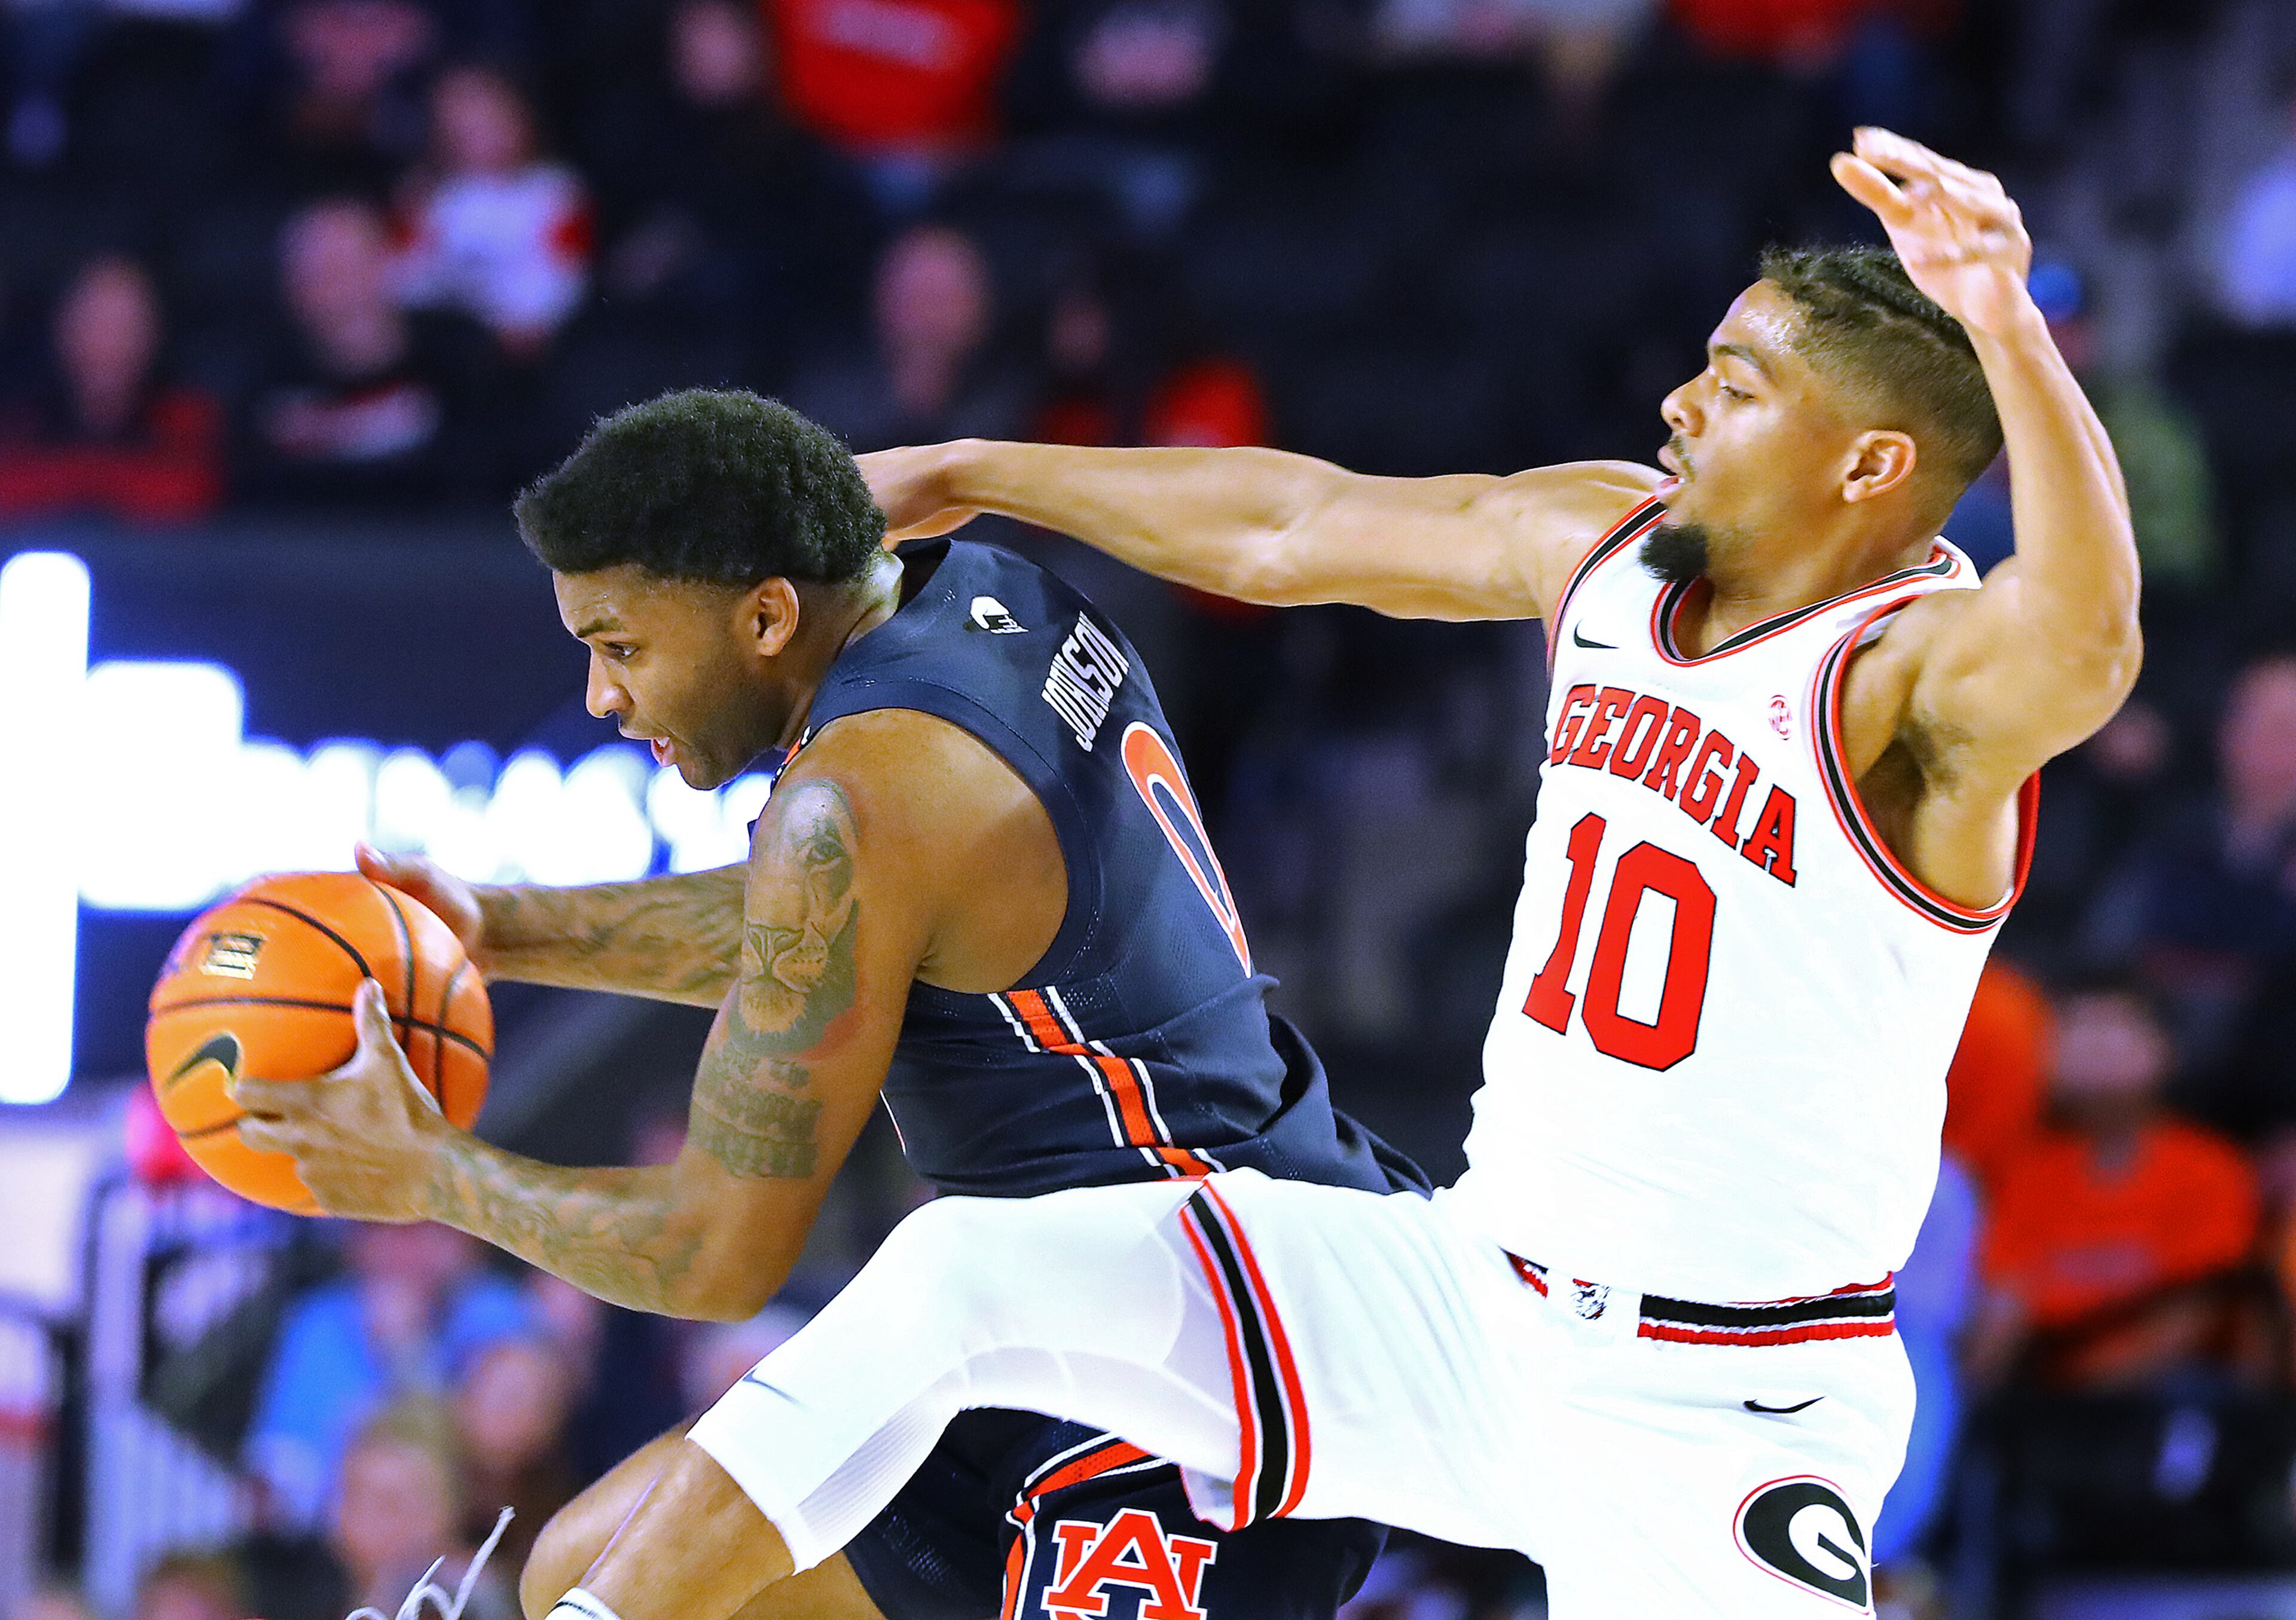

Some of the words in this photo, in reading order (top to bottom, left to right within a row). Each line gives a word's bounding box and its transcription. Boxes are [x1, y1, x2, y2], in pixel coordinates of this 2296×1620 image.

[1041, 610, 1129, 752] JOHNSON
[1550, 684, 1797, 888] GEORGIA
[1522, 812, 1717, 1072] 10
[1733, 1474, 1870, 1615] G
